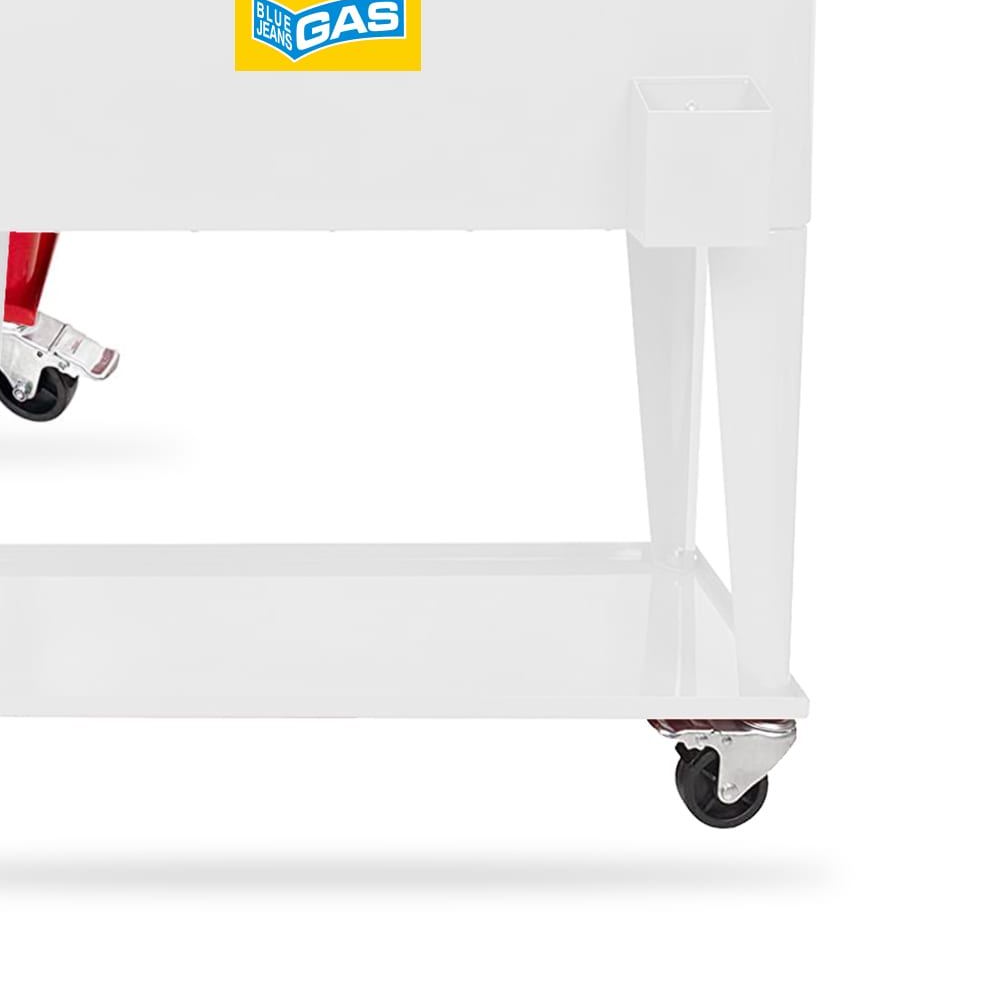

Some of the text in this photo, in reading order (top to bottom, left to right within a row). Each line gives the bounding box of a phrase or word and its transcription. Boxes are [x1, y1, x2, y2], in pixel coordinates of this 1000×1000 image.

[256, 1, 291, 33] BLUE
[296, 1, 399, 51] GAS
[256, 20, 293, 51] JEANS
